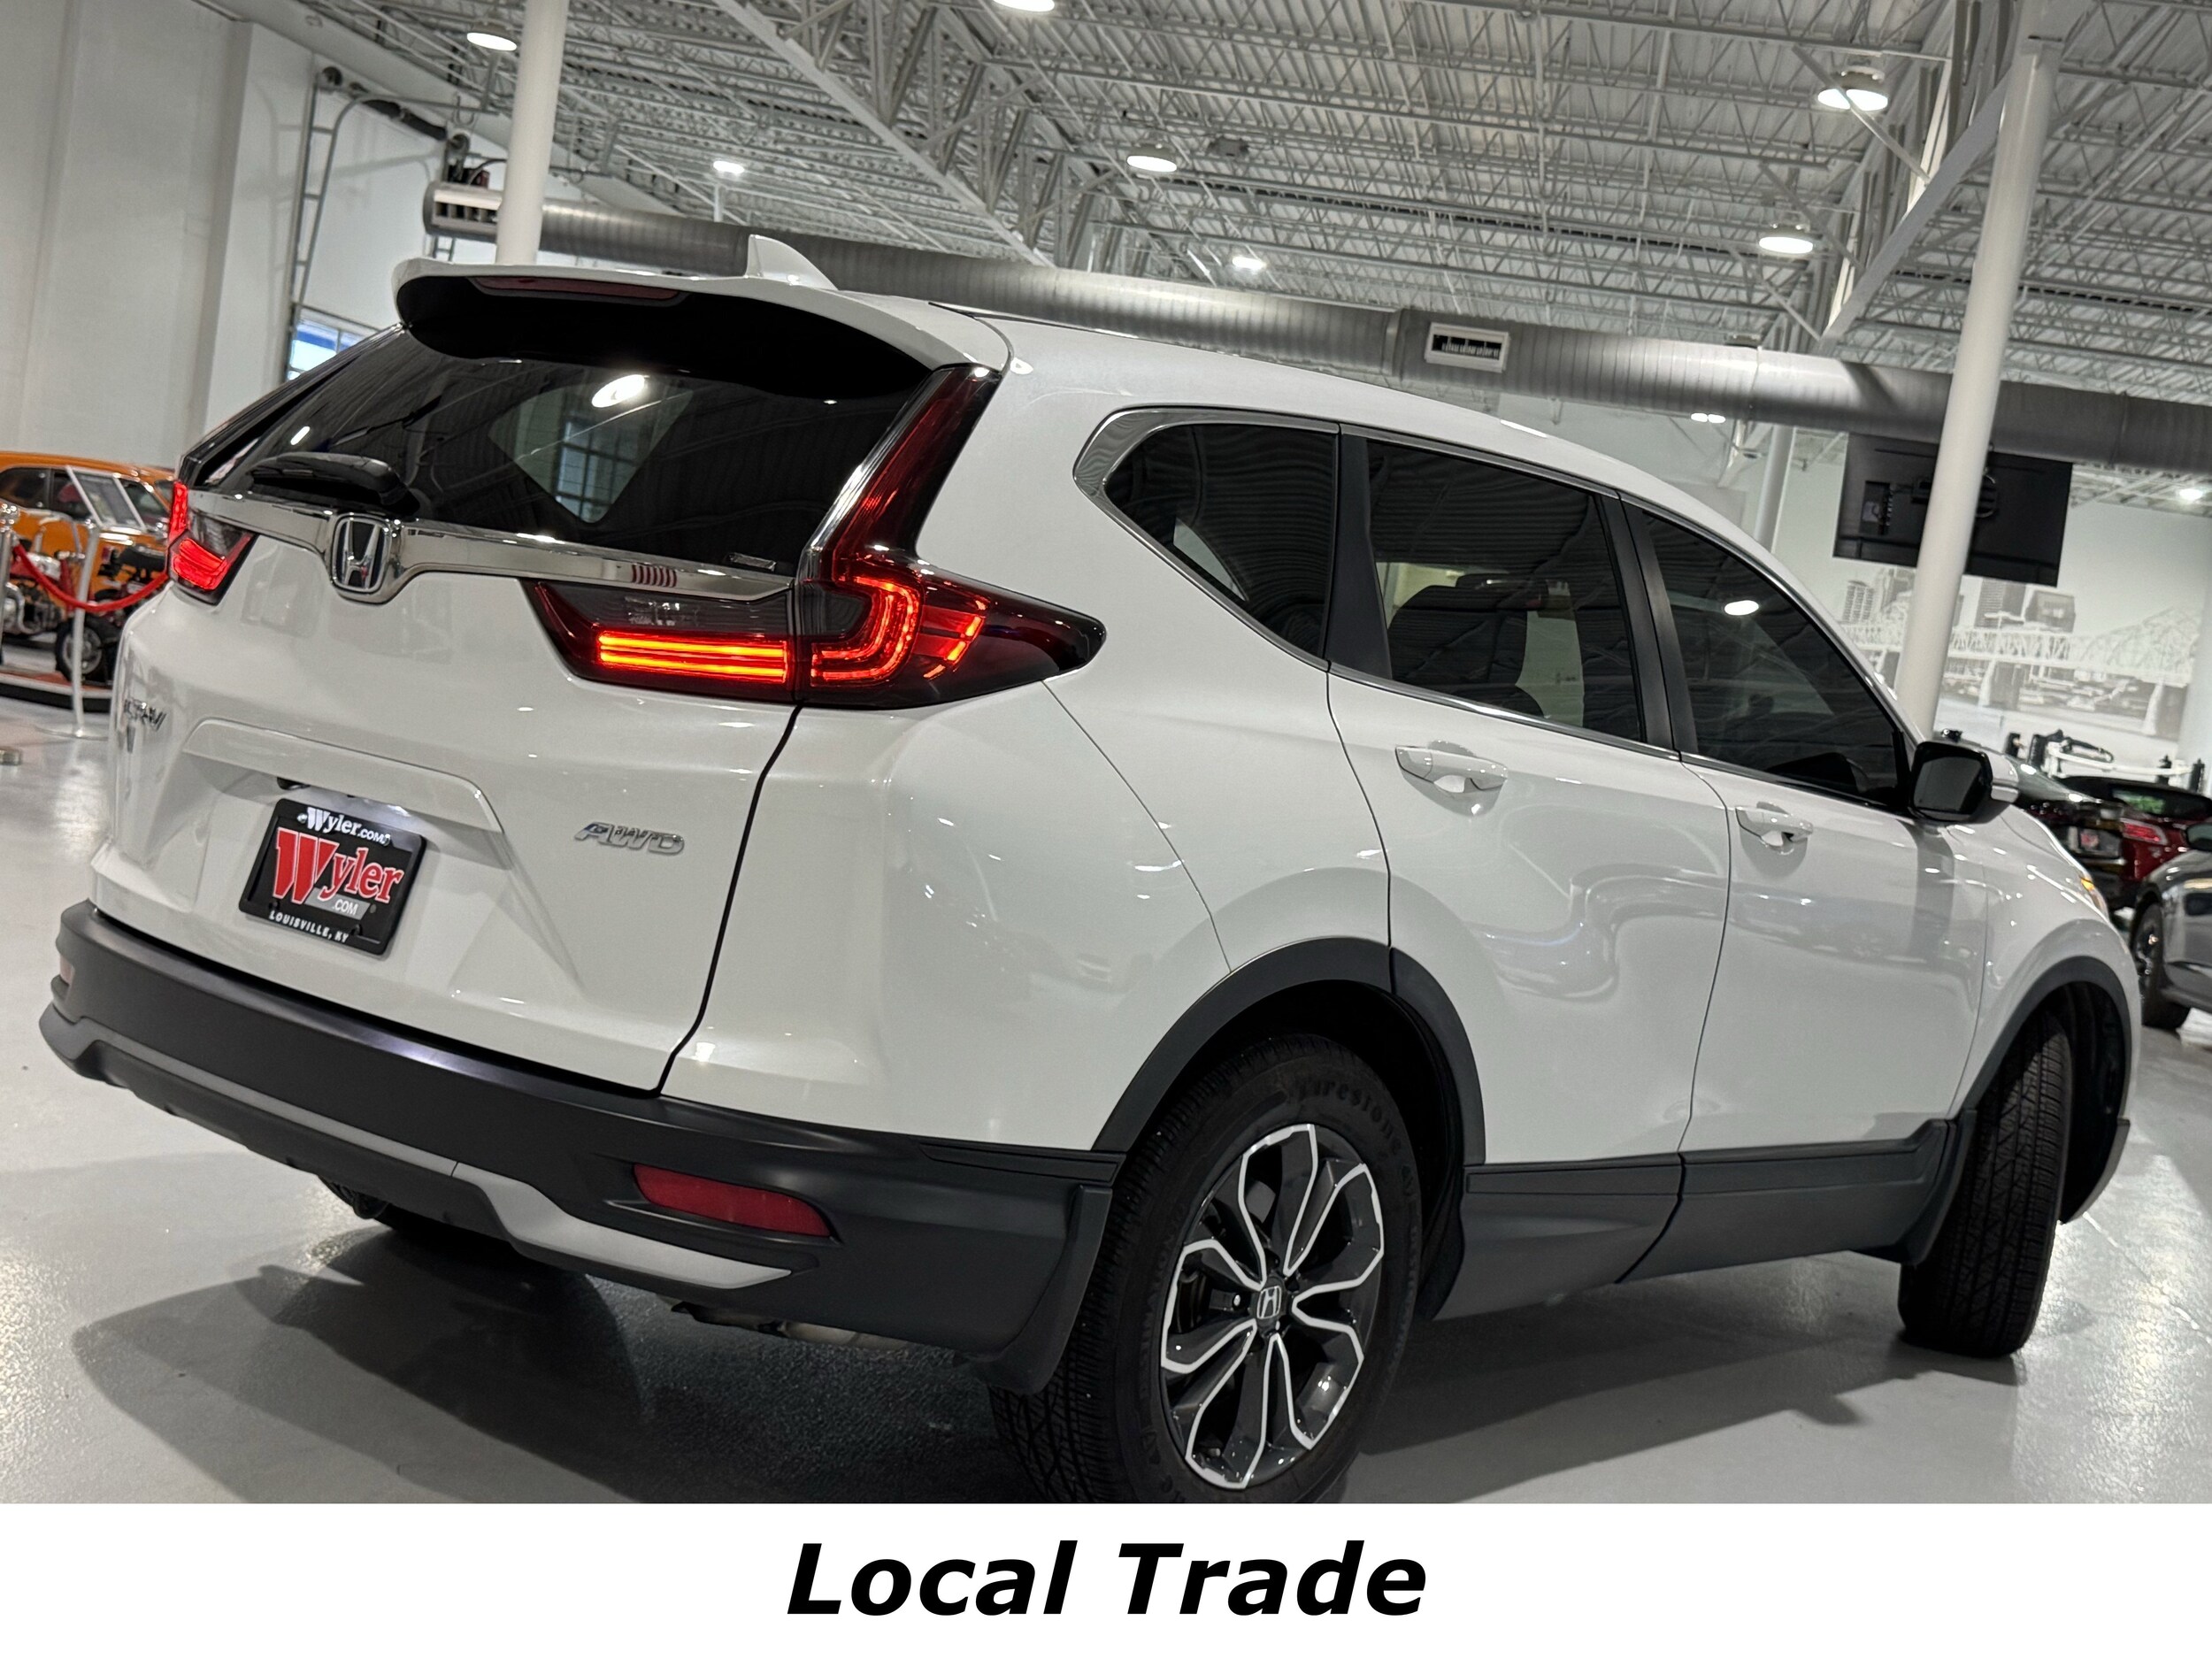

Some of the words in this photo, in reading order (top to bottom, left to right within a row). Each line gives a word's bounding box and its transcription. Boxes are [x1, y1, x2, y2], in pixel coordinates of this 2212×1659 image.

[575, 821, 686, 856] AWD
[273, 826, 405, 905] Wyler
[268, 910, 333, 941] LOUISVILLE,
[334, 930, 349, 944] KY
